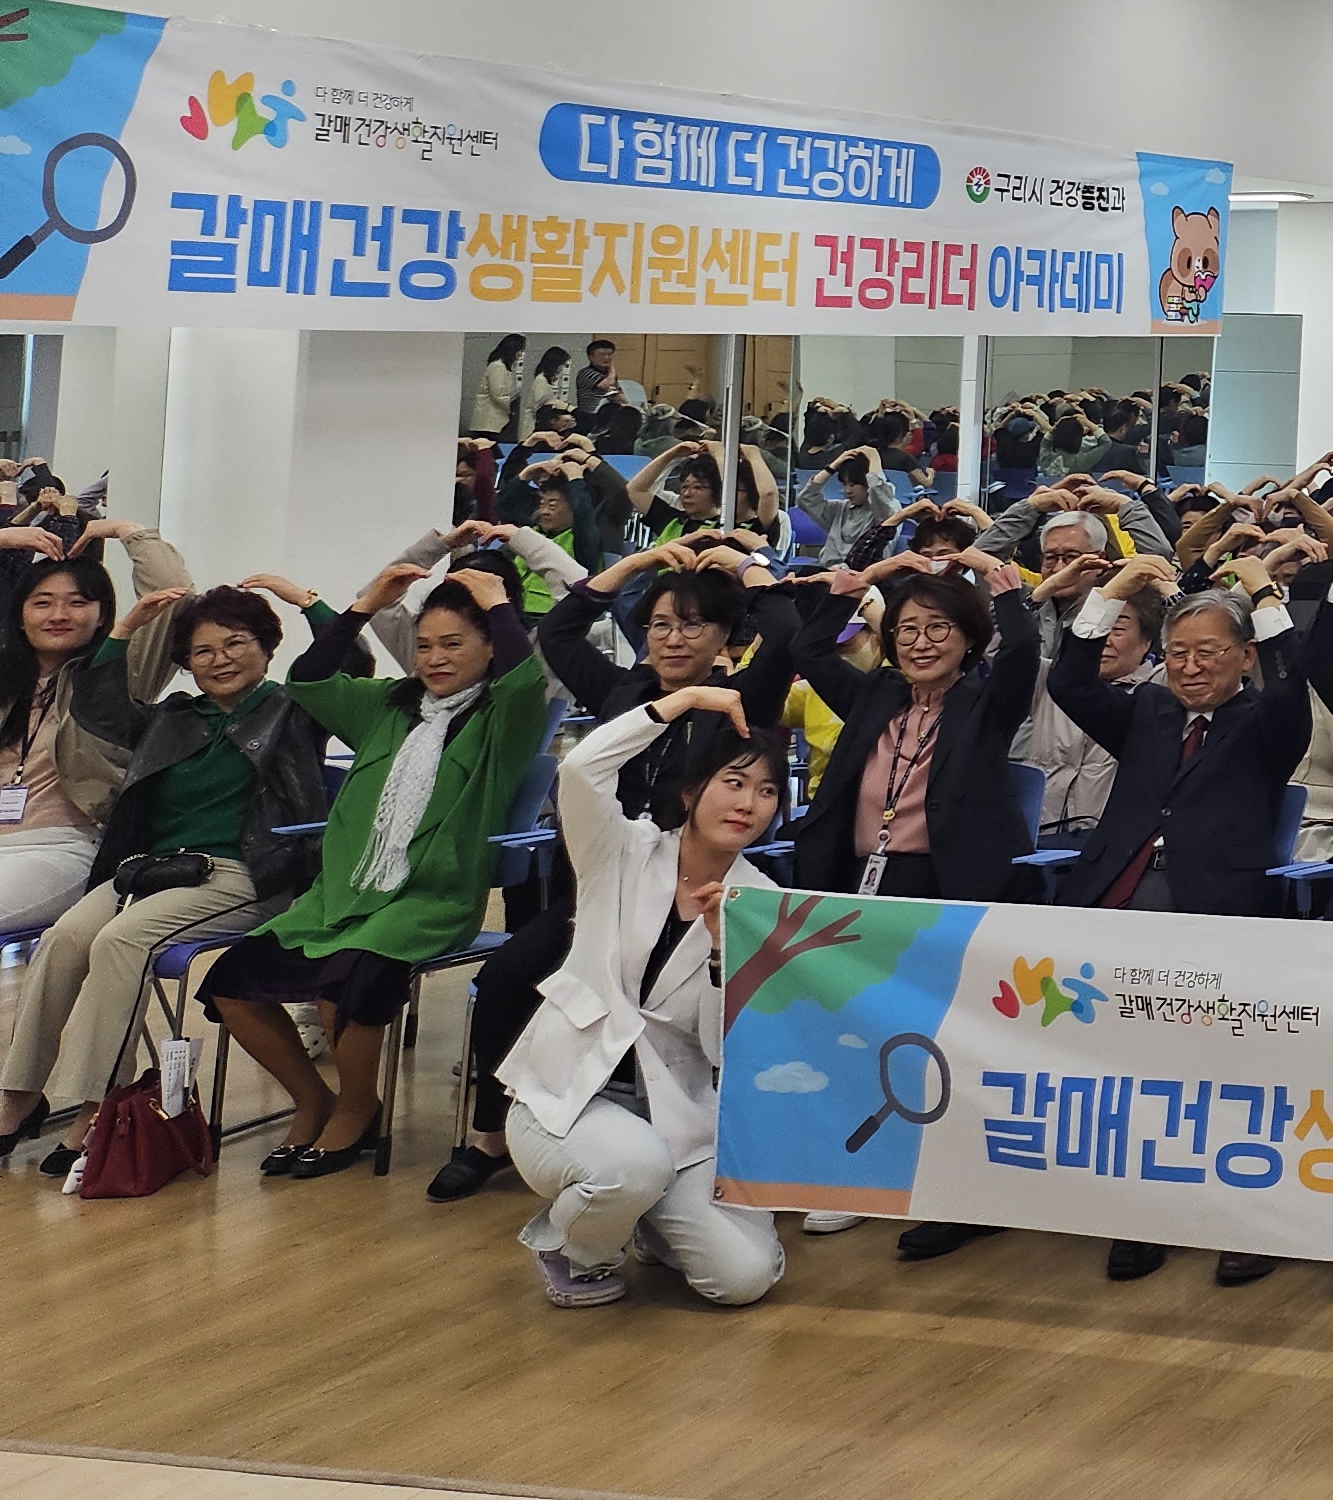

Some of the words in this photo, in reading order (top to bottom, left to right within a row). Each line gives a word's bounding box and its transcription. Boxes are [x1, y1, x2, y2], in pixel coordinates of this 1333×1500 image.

[315, 86, 328, 102] 다
[331, 88, 354, 105] 함께
[358, 91, 368, 107] 더
[373, 93, 414, 112] 건강하게
[633, 118, 718, 189] 함께
[727, 131, 765, 192] 더
[776, 135, 915, 205] 건강하게
[993, 172, 1045, 206] 구리시
[1048, 179, 1126, 213] 건강증진과
[168, 192, 798, 307] 갈매건강생활지원센터
[815, 235, 977, 311] 건강리더
[988, 245, 1124, 314] 아카데미
[1114, 967, 1126, 985] 다
[1129, 968, 1153, 987] 함께
[1157, 969, 1169, 987] 더
[1173, 970, 1223, 991] 건강하게
